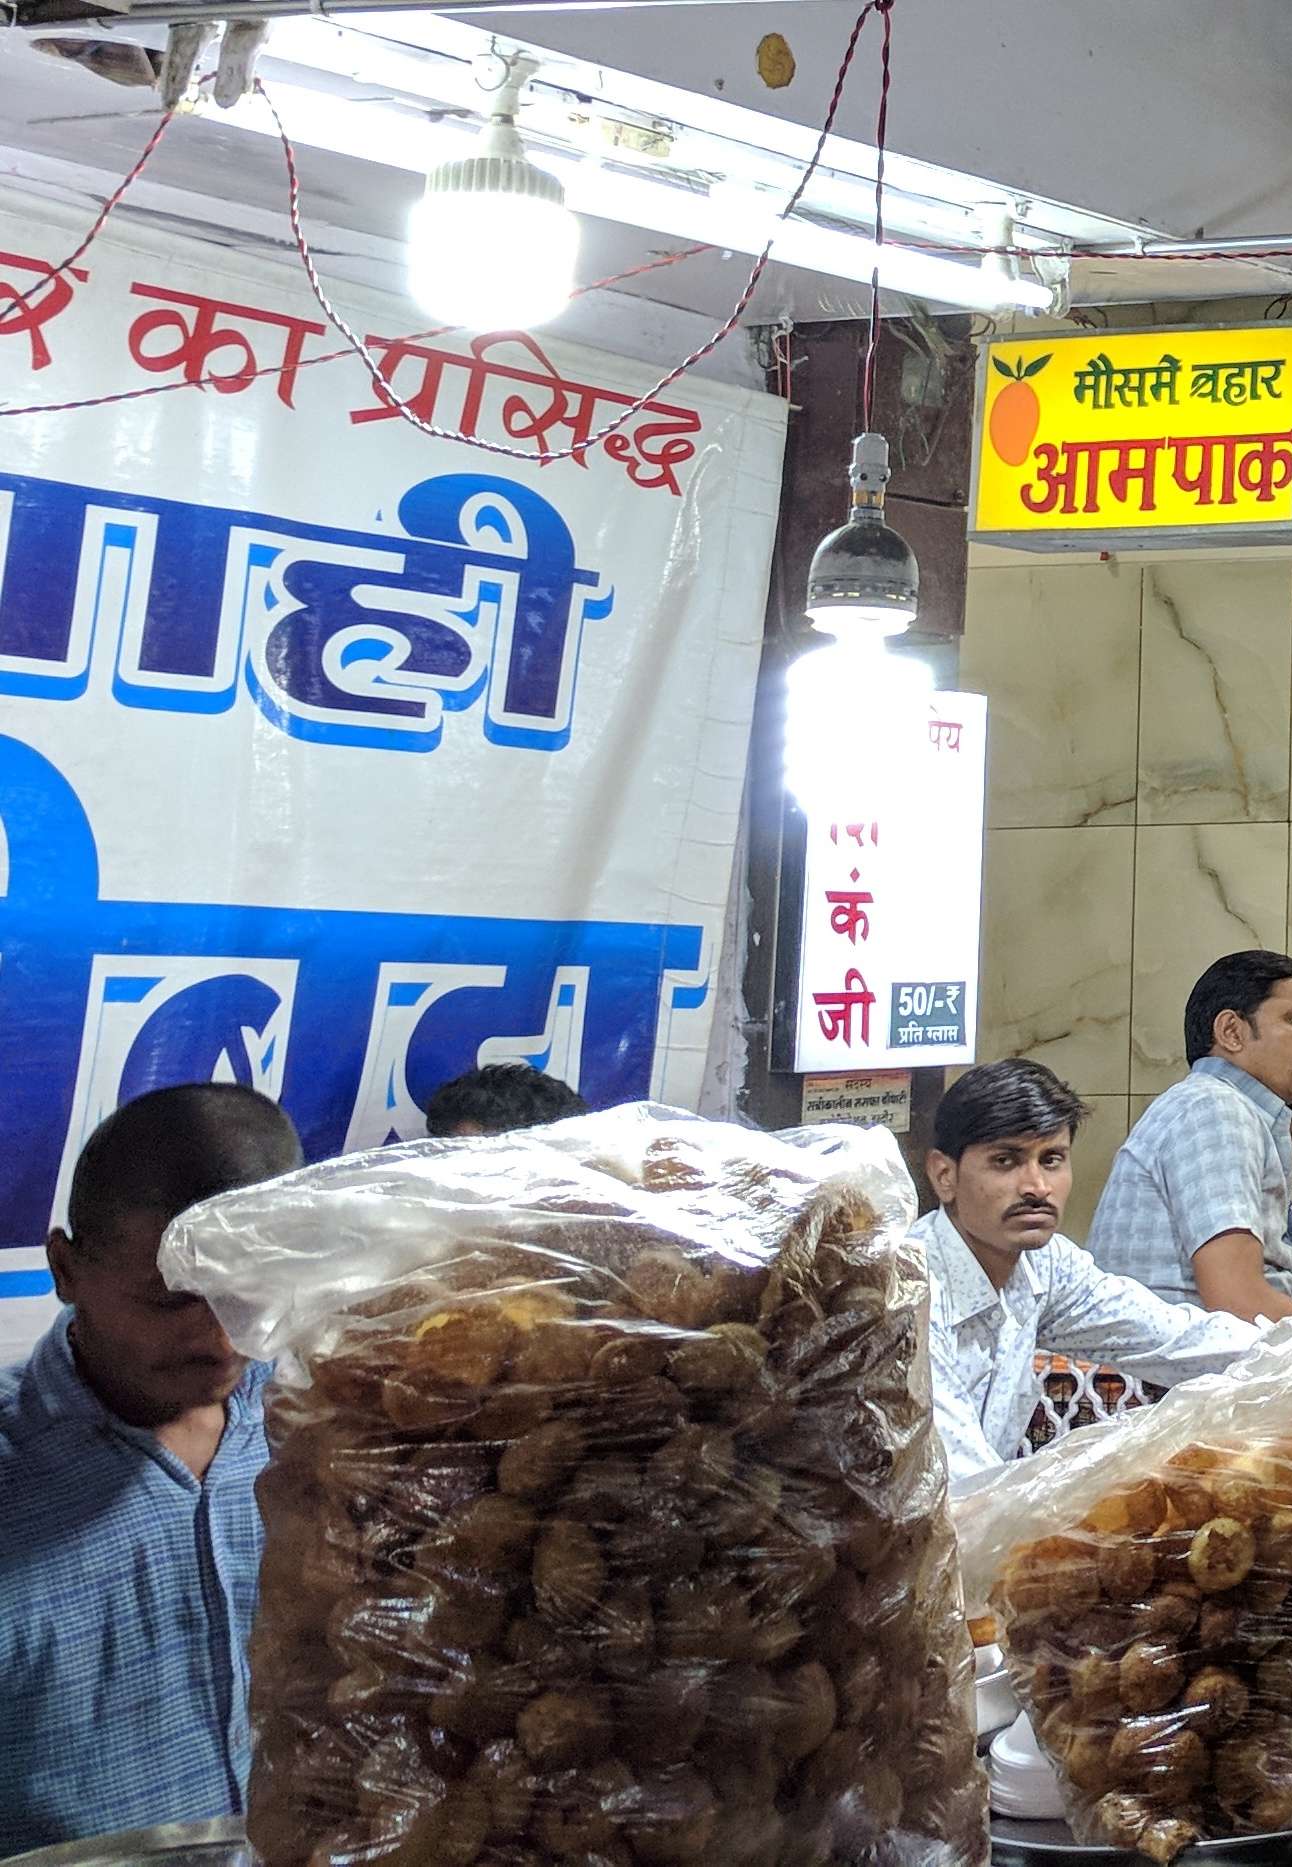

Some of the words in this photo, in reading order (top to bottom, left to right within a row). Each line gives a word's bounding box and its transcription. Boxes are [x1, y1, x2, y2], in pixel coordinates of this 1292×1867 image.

[129, 282, 327, 409] का
[349, 332, 703, 496] प्रसिद्ध
[897, 1023, 923, 1045] प्रति
[926, 1022, 959, 1044] ग्लास
